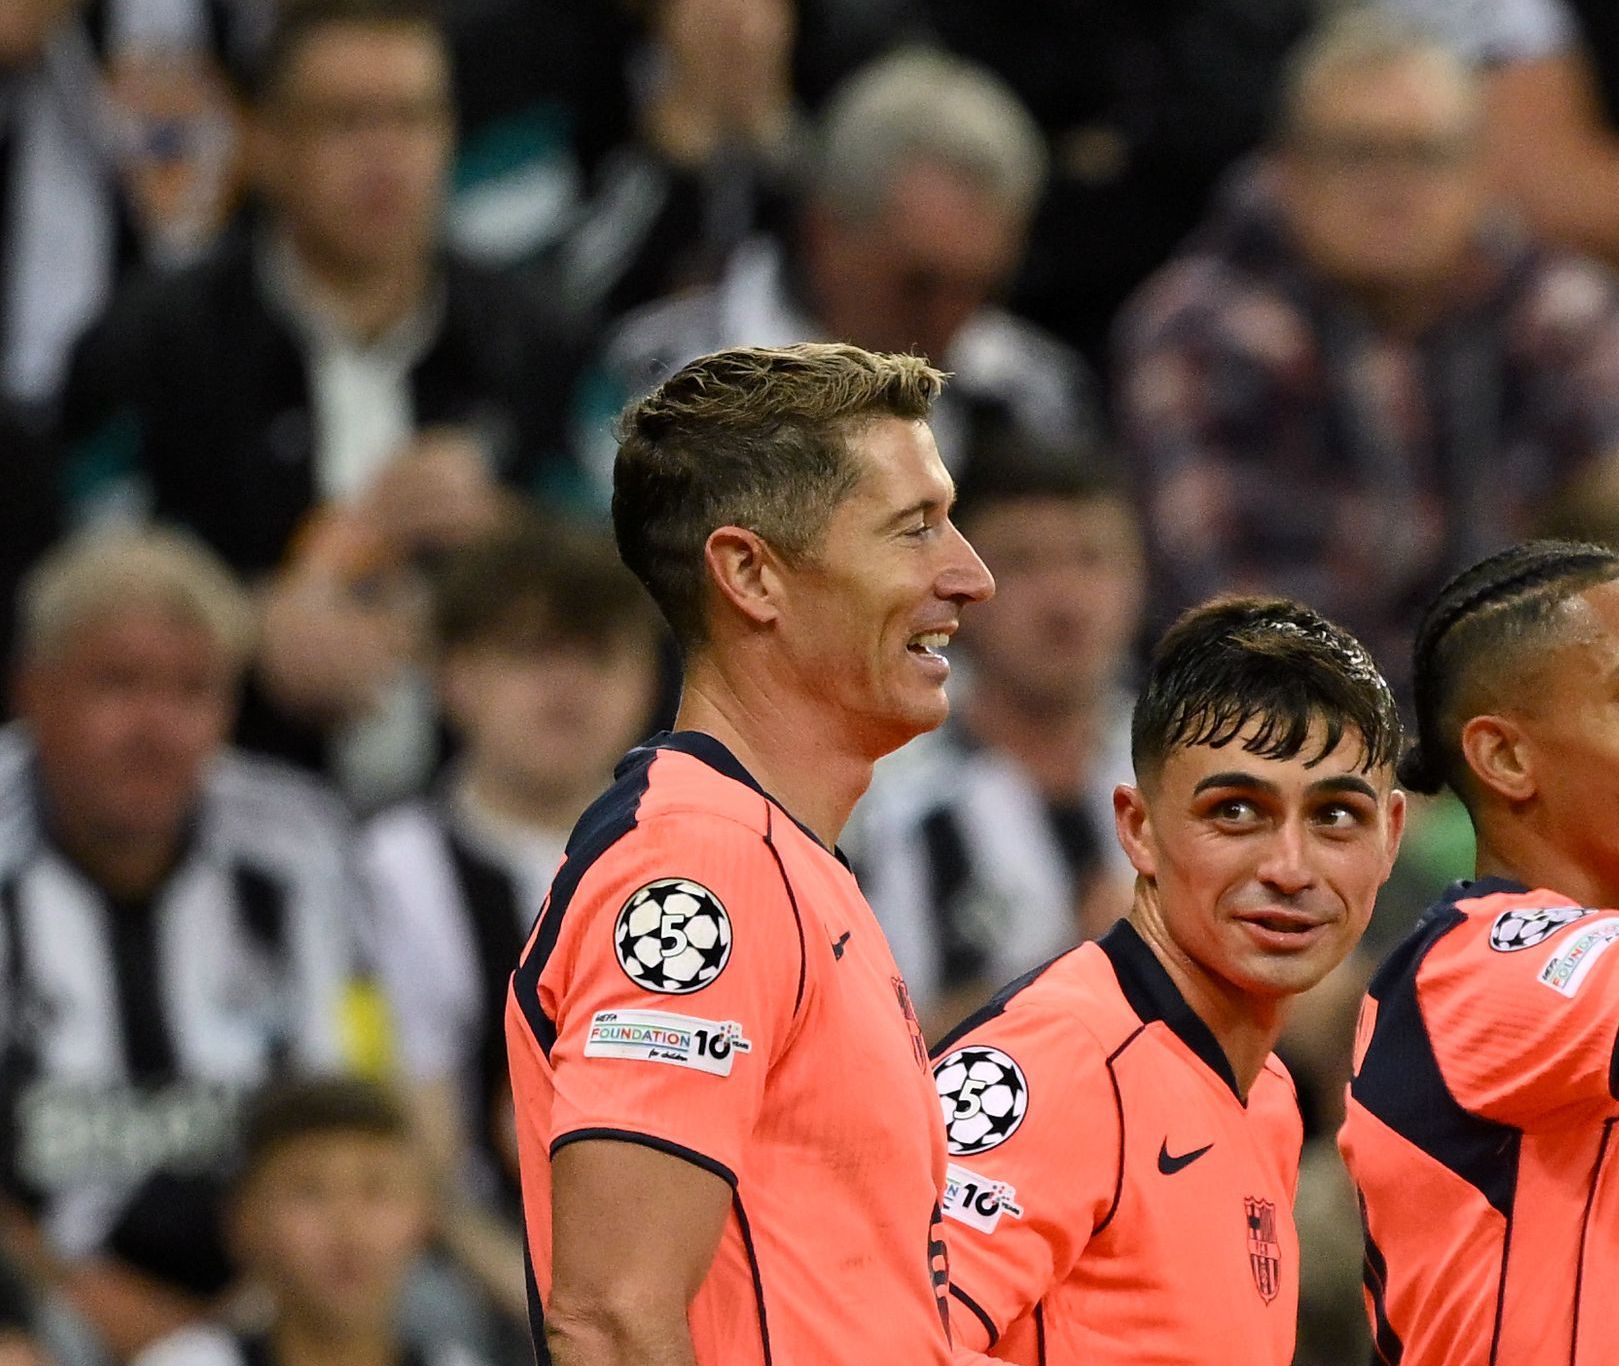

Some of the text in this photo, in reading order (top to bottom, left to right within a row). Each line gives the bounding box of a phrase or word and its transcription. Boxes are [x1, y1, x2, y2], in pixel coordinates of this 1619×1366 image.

[660, 914, 688, 958] 5
[591, 1027, 690, 1048] FOUNDATION
[694, 1029, 731, 1060] 10
[952, 1077, 988, 1121] 5
